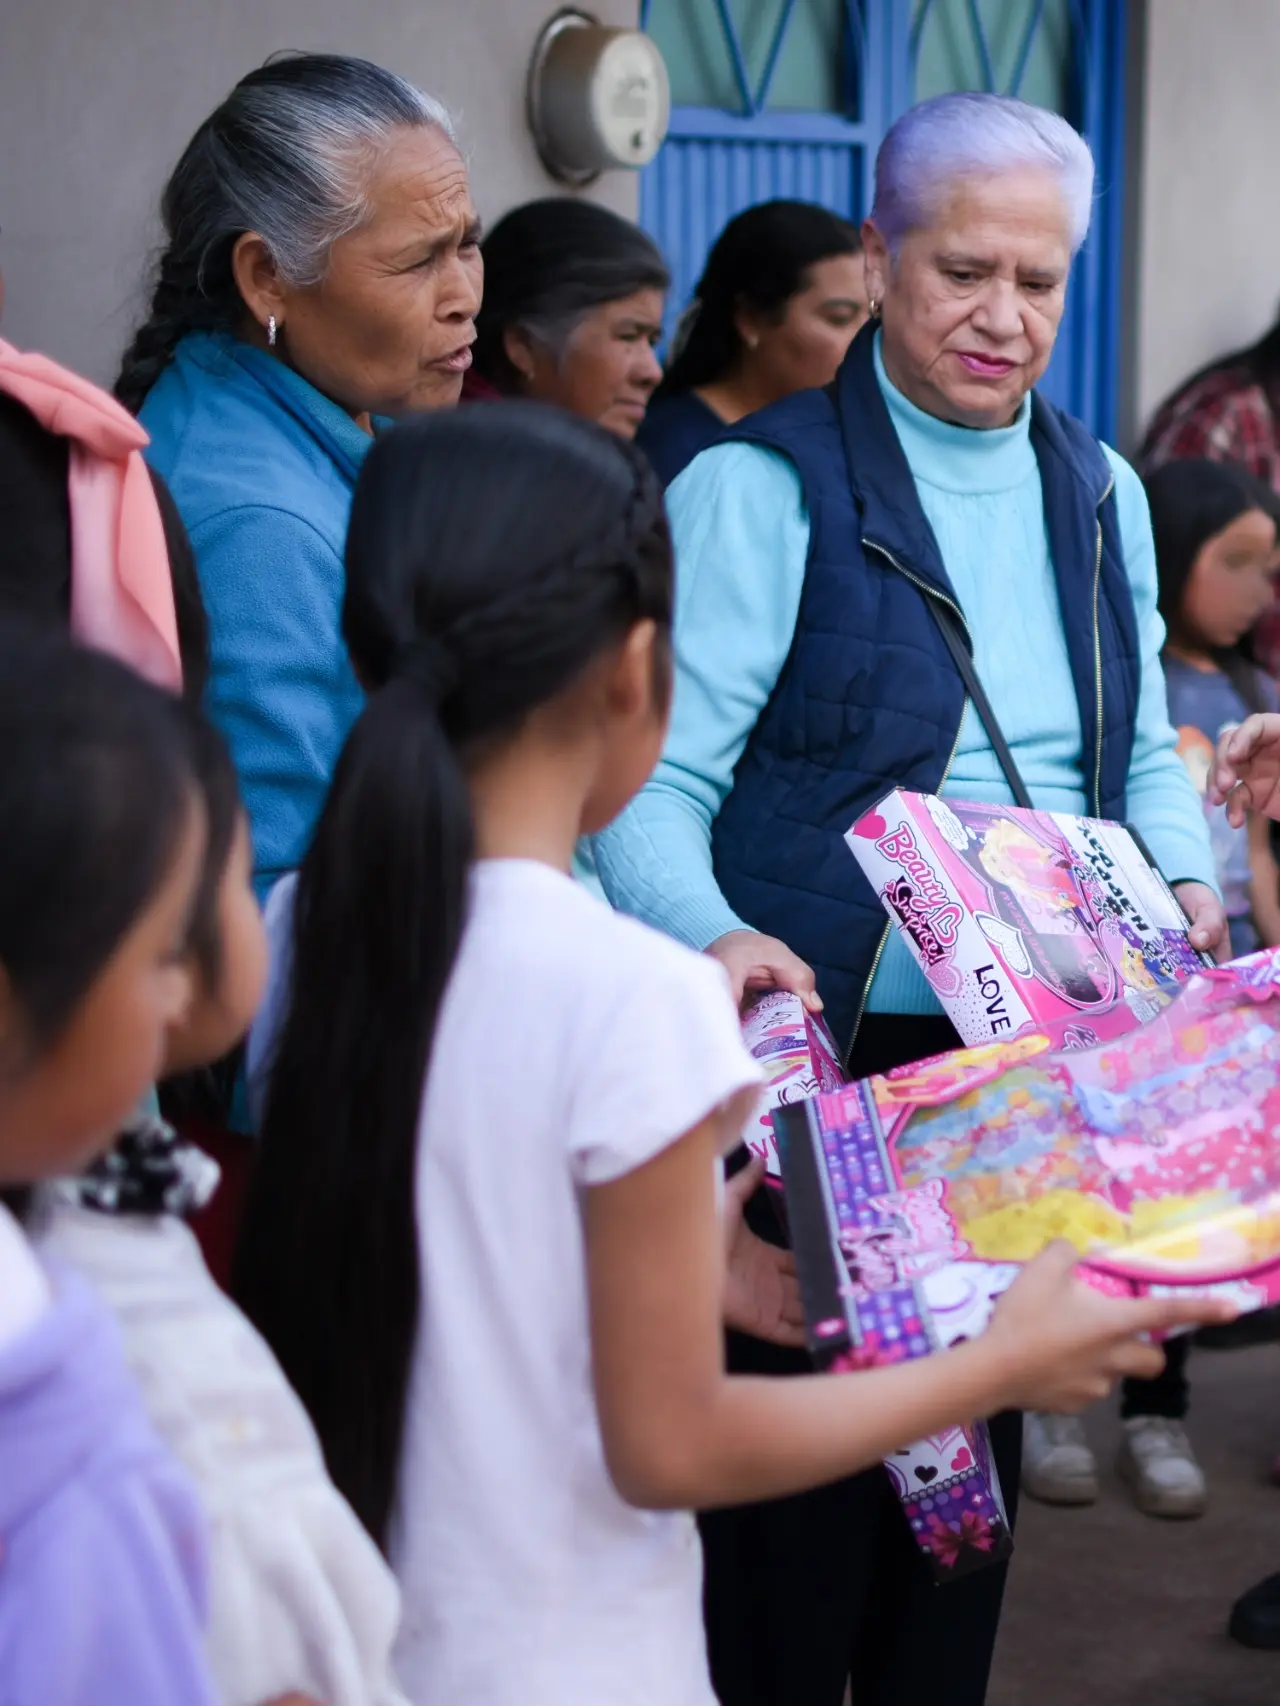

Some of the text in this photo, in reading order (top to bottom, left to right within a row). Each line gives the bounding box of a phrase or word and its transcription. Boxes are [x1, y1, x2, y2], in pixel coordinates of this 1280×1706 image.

[876, 821, 949, 912] Beauty
[885, 880, 952, 964] Surprise!
[973, 964, 1011, 1035] LOVE
